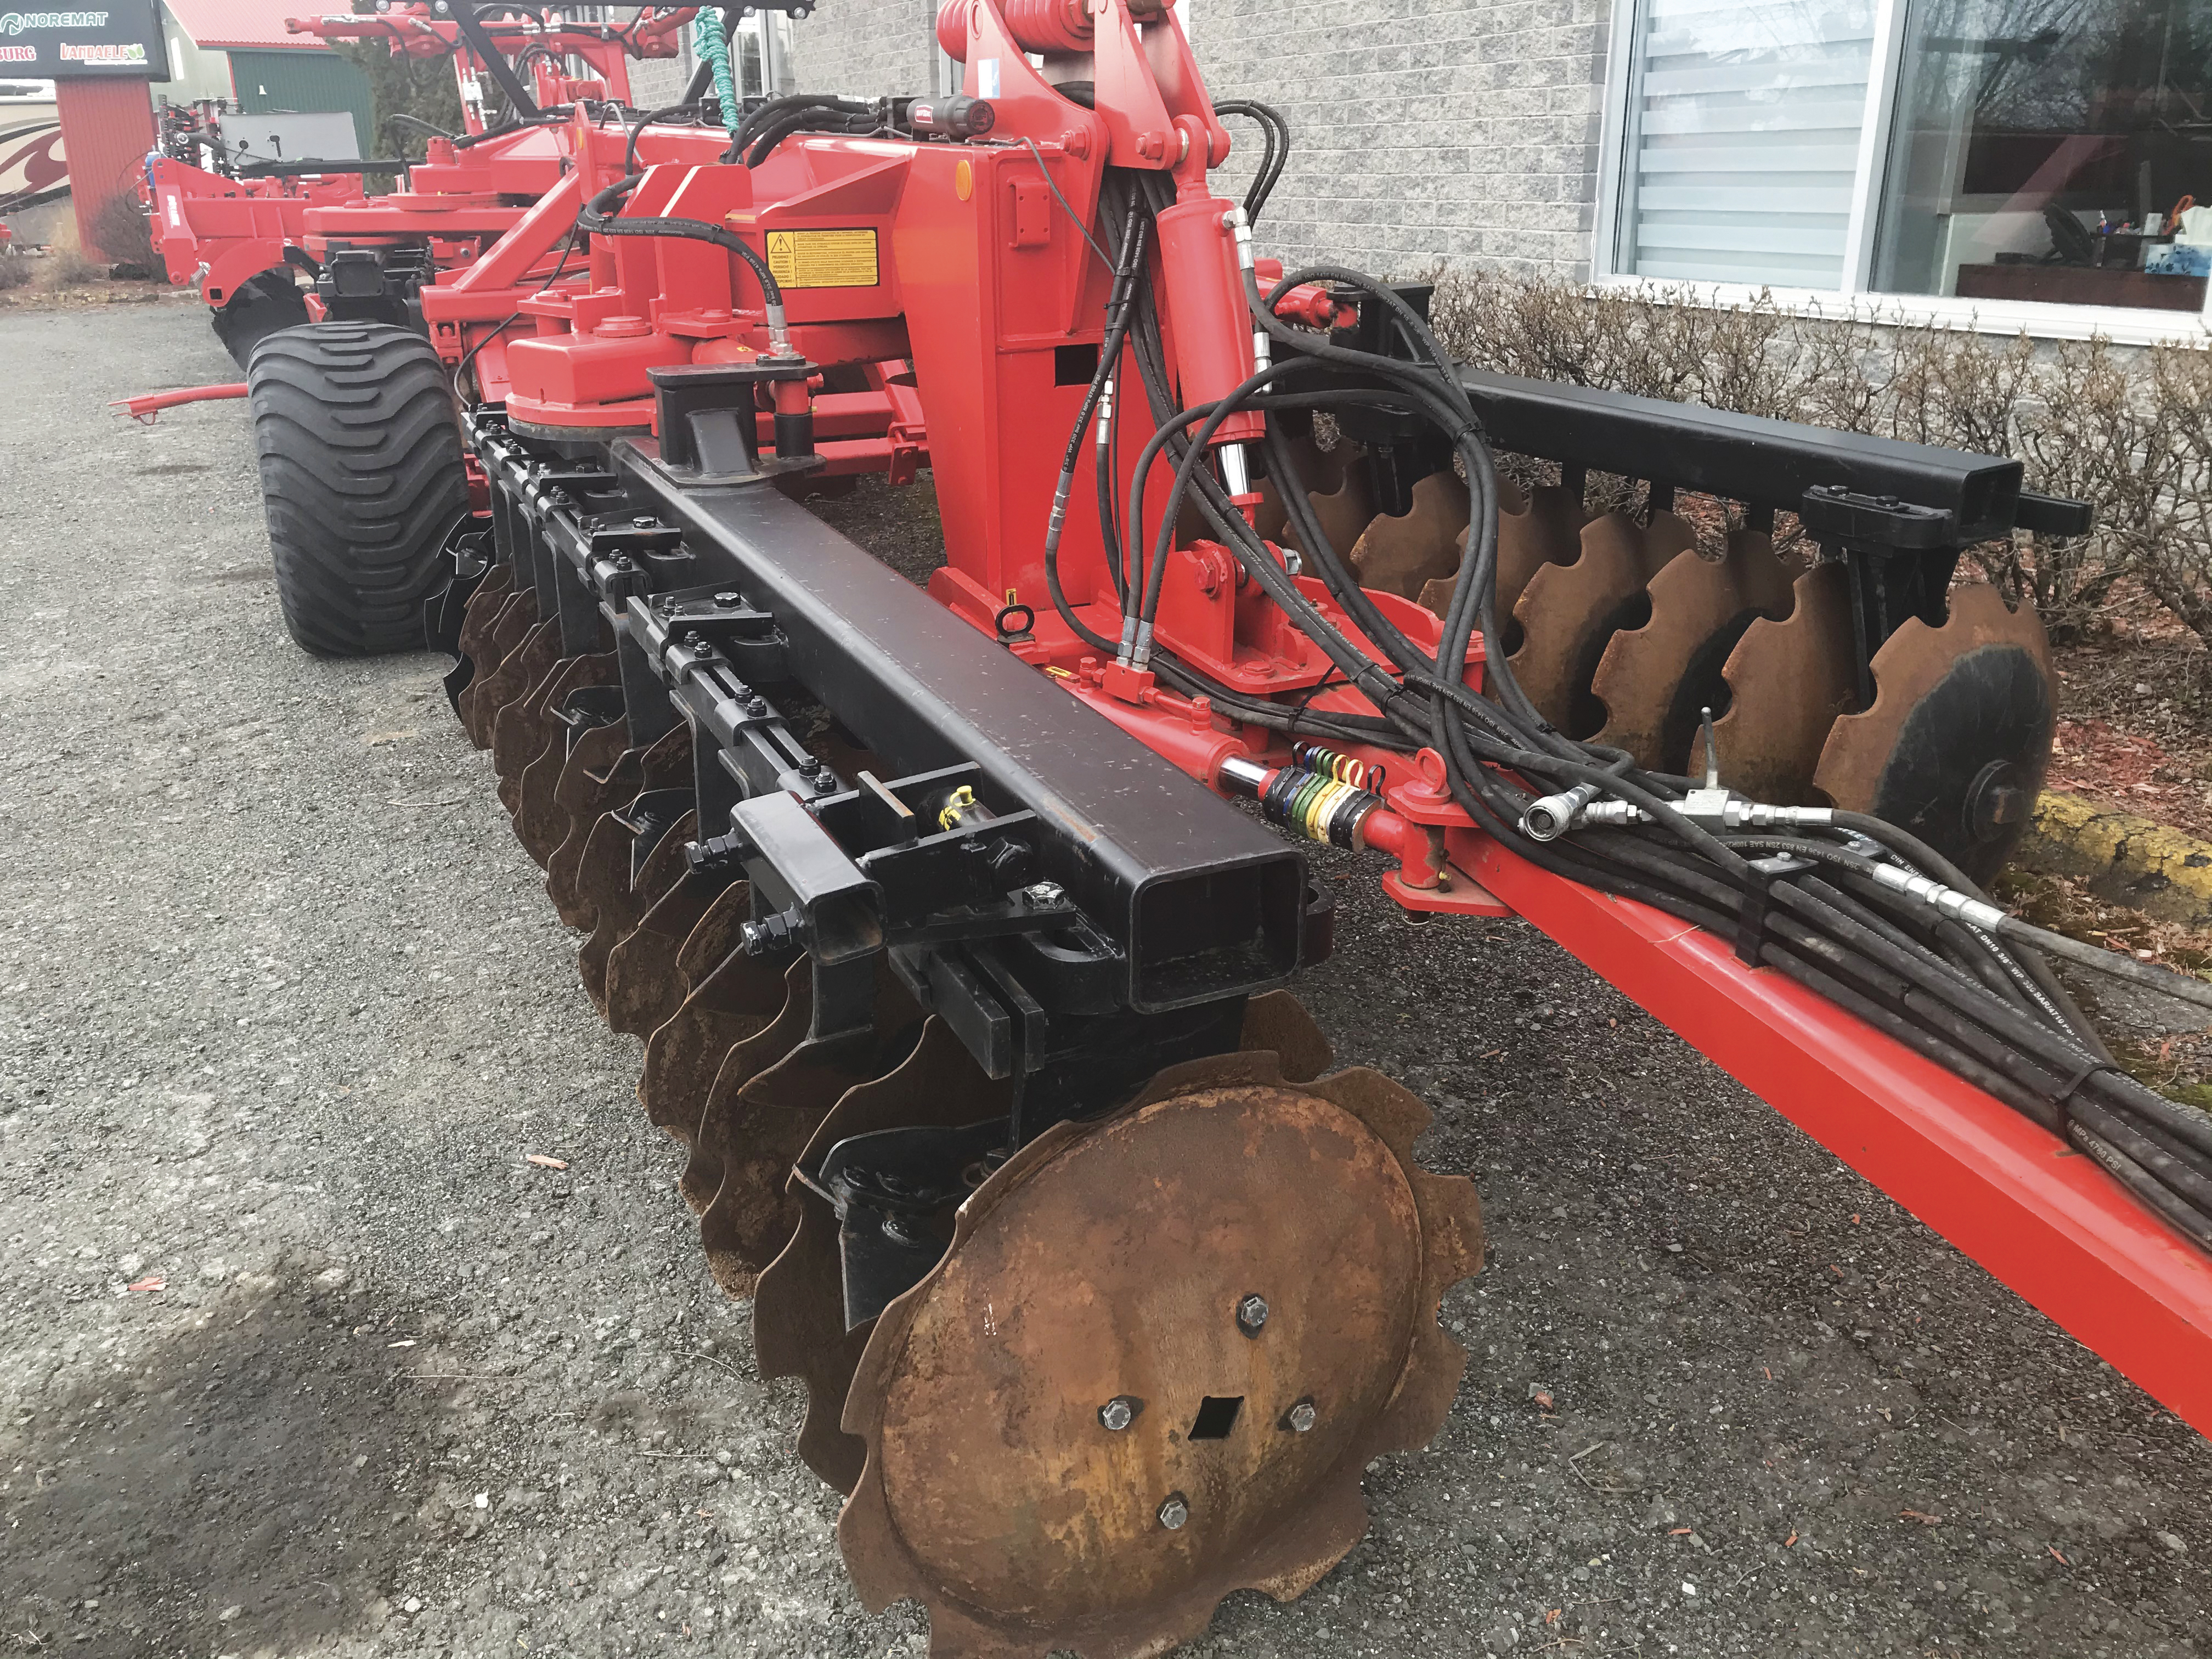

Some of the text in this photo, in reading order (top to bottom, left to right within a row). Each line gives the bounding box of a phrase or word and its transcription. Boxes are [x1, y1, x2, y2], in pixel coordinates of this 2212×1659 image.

[25, 12, 108, 27] NOREMAT
[0, 46, 36, 61] URG
[60, 43, 128, 60] VANDAELE
[1395, 307, 1403, 315] DN
[1422, 337, 1430, 346] WP
[1068, 443, 1073, 453] WP
[1088, 385, 1097, 398] 4780
[1432, 682, 1442, 692] SAE
[1463, 701, 1471, 710] EN
[1471, 707, 1484, 719] 1436
[1485, 717, 1496, 727] ISO
[1782, 843, 1795, 851] 853
[1796, 845, 1807, 853] EN
[1808, 848, 1825, 858] 1436
[1826, 853, 1842, 864] ISO
[1843, 859, 1861, 870] 2SN
[1890, 854, 1905, 865] DIN
[1917, 945, 1933, 955] PSI
[1980, 935, 1999, 952] DN10
[1997, 952, 2013, 965] 3/8"
[2011, 967, 2024, 978] WP
[2034, 991, 2065, 1024] BAR/4710
[2073, 1124, 2121, 1171] MPa 4780 PSI
